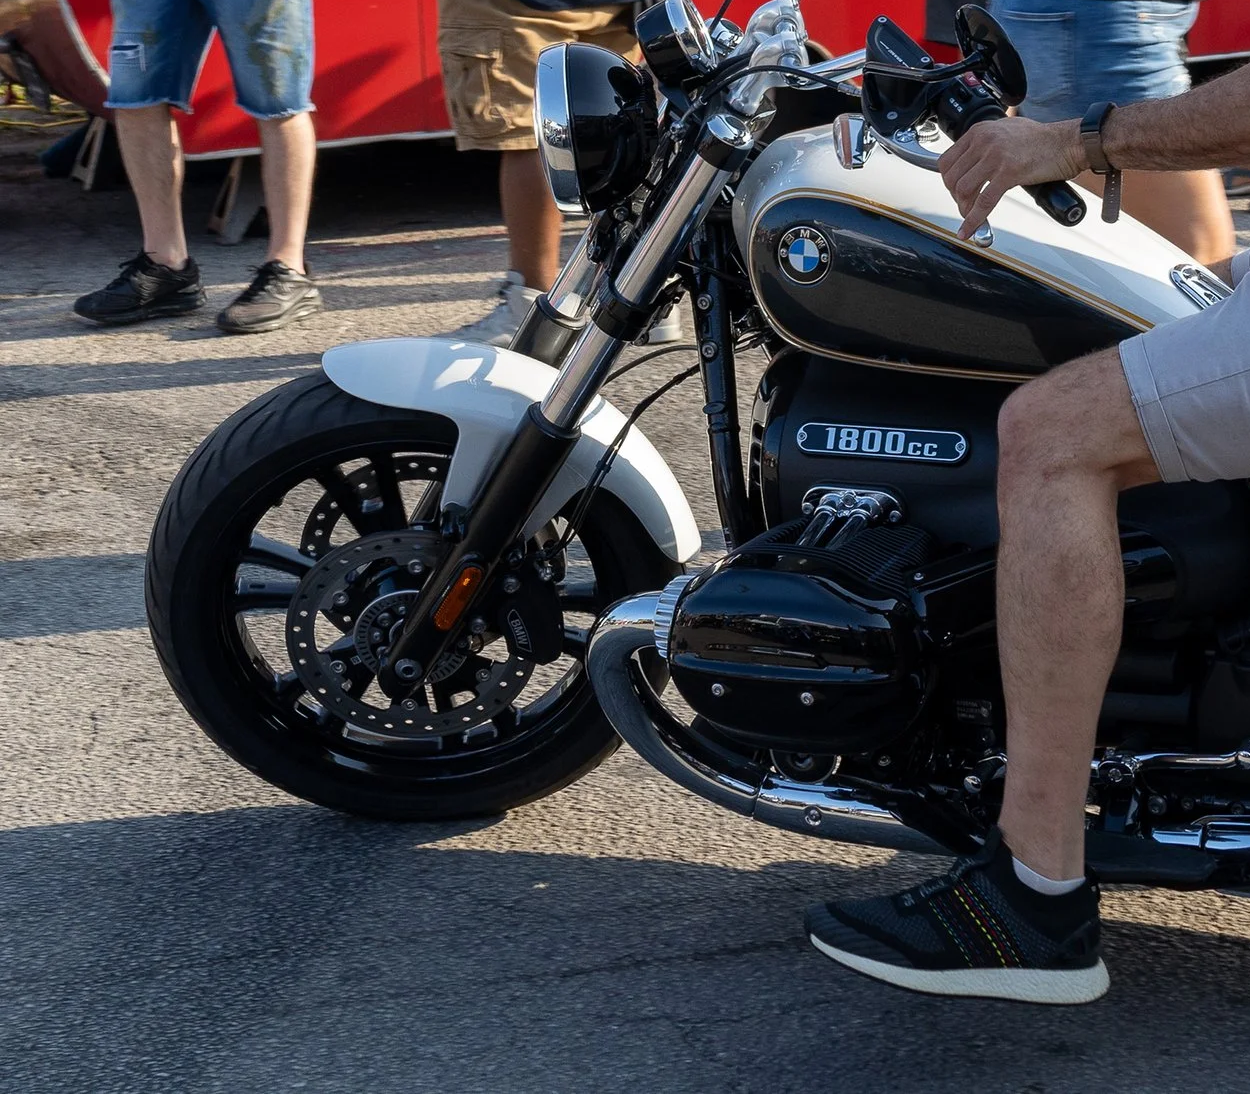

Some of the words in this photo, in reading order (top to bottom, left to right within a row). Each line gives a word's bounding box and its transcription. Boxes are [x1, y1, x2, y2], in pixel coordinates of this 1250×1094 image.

[785, 229, 826, 250] BMW
[825, 427, 938, 457] 1800cc
[510, 618, 529, 645] BMW
